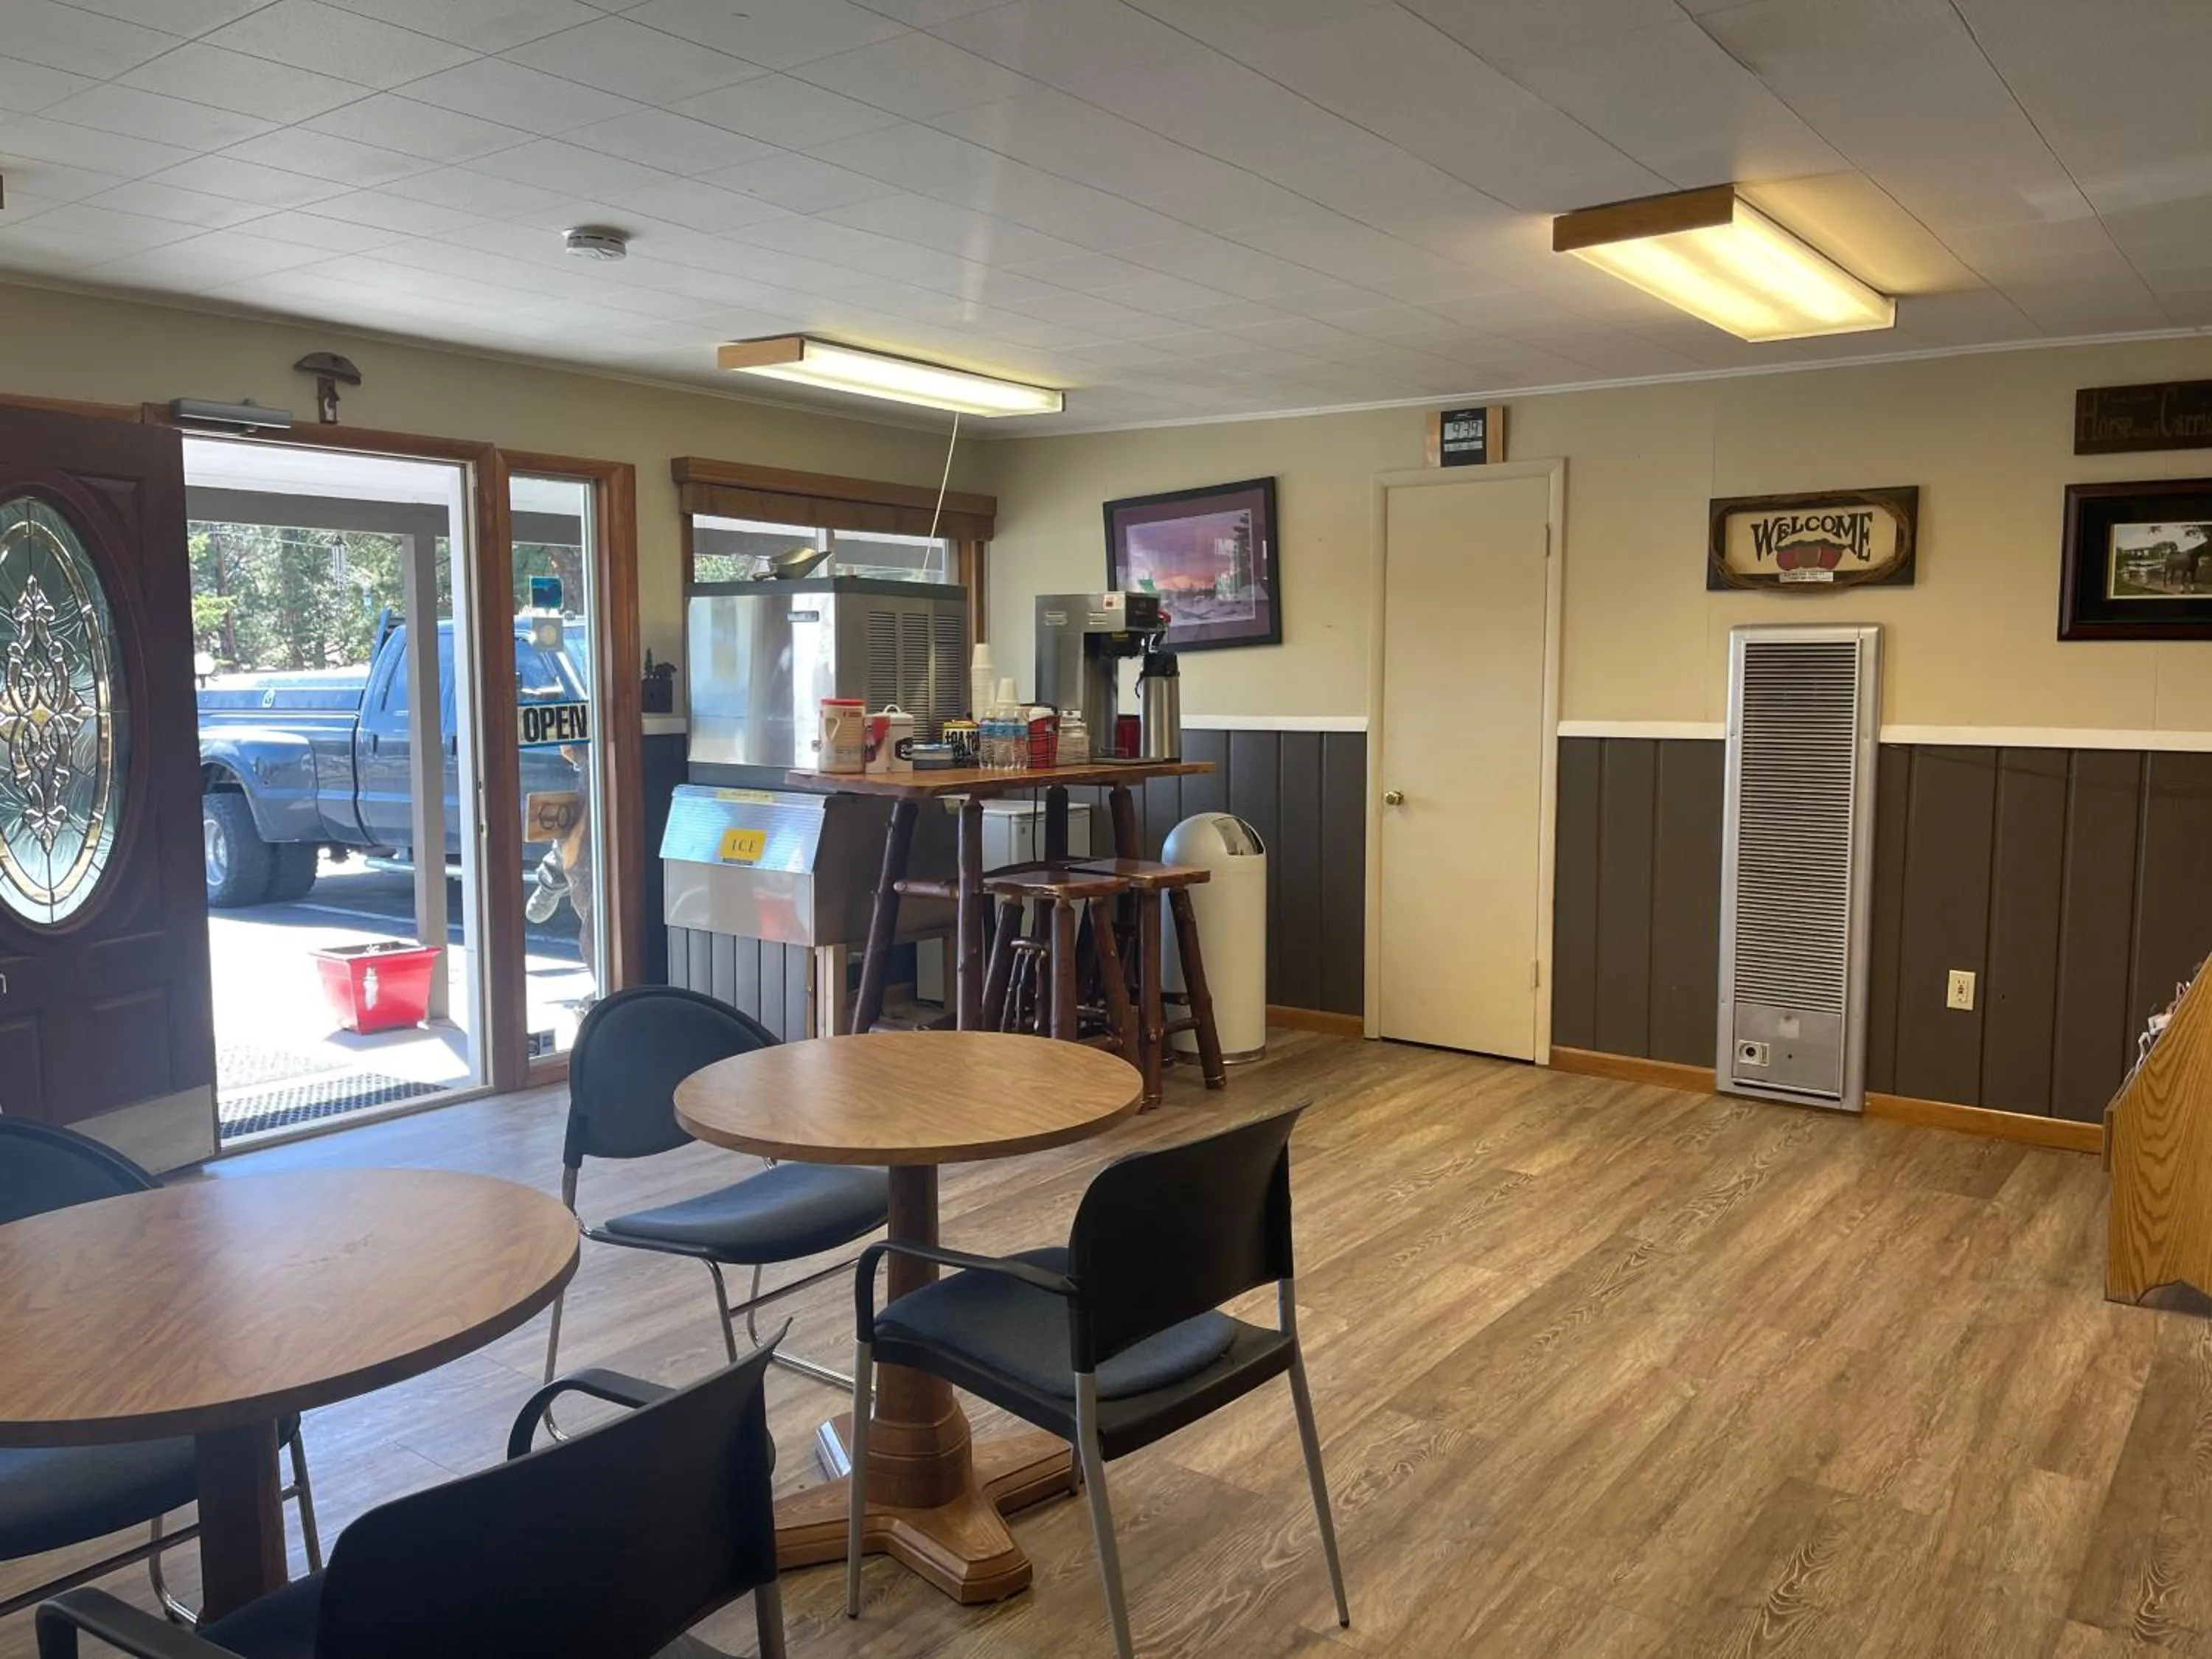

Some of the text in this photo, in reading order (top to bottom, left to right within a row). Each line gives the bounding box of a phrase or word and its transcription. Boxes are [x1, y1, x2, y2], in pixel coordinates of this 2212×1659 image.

[2076, 391, 2132, 442] Horse
[1750, 512, 1873, 562] WELCOME
[523, 705, 588, 742] OPEN
[731, 838, 756, 853] ICE
